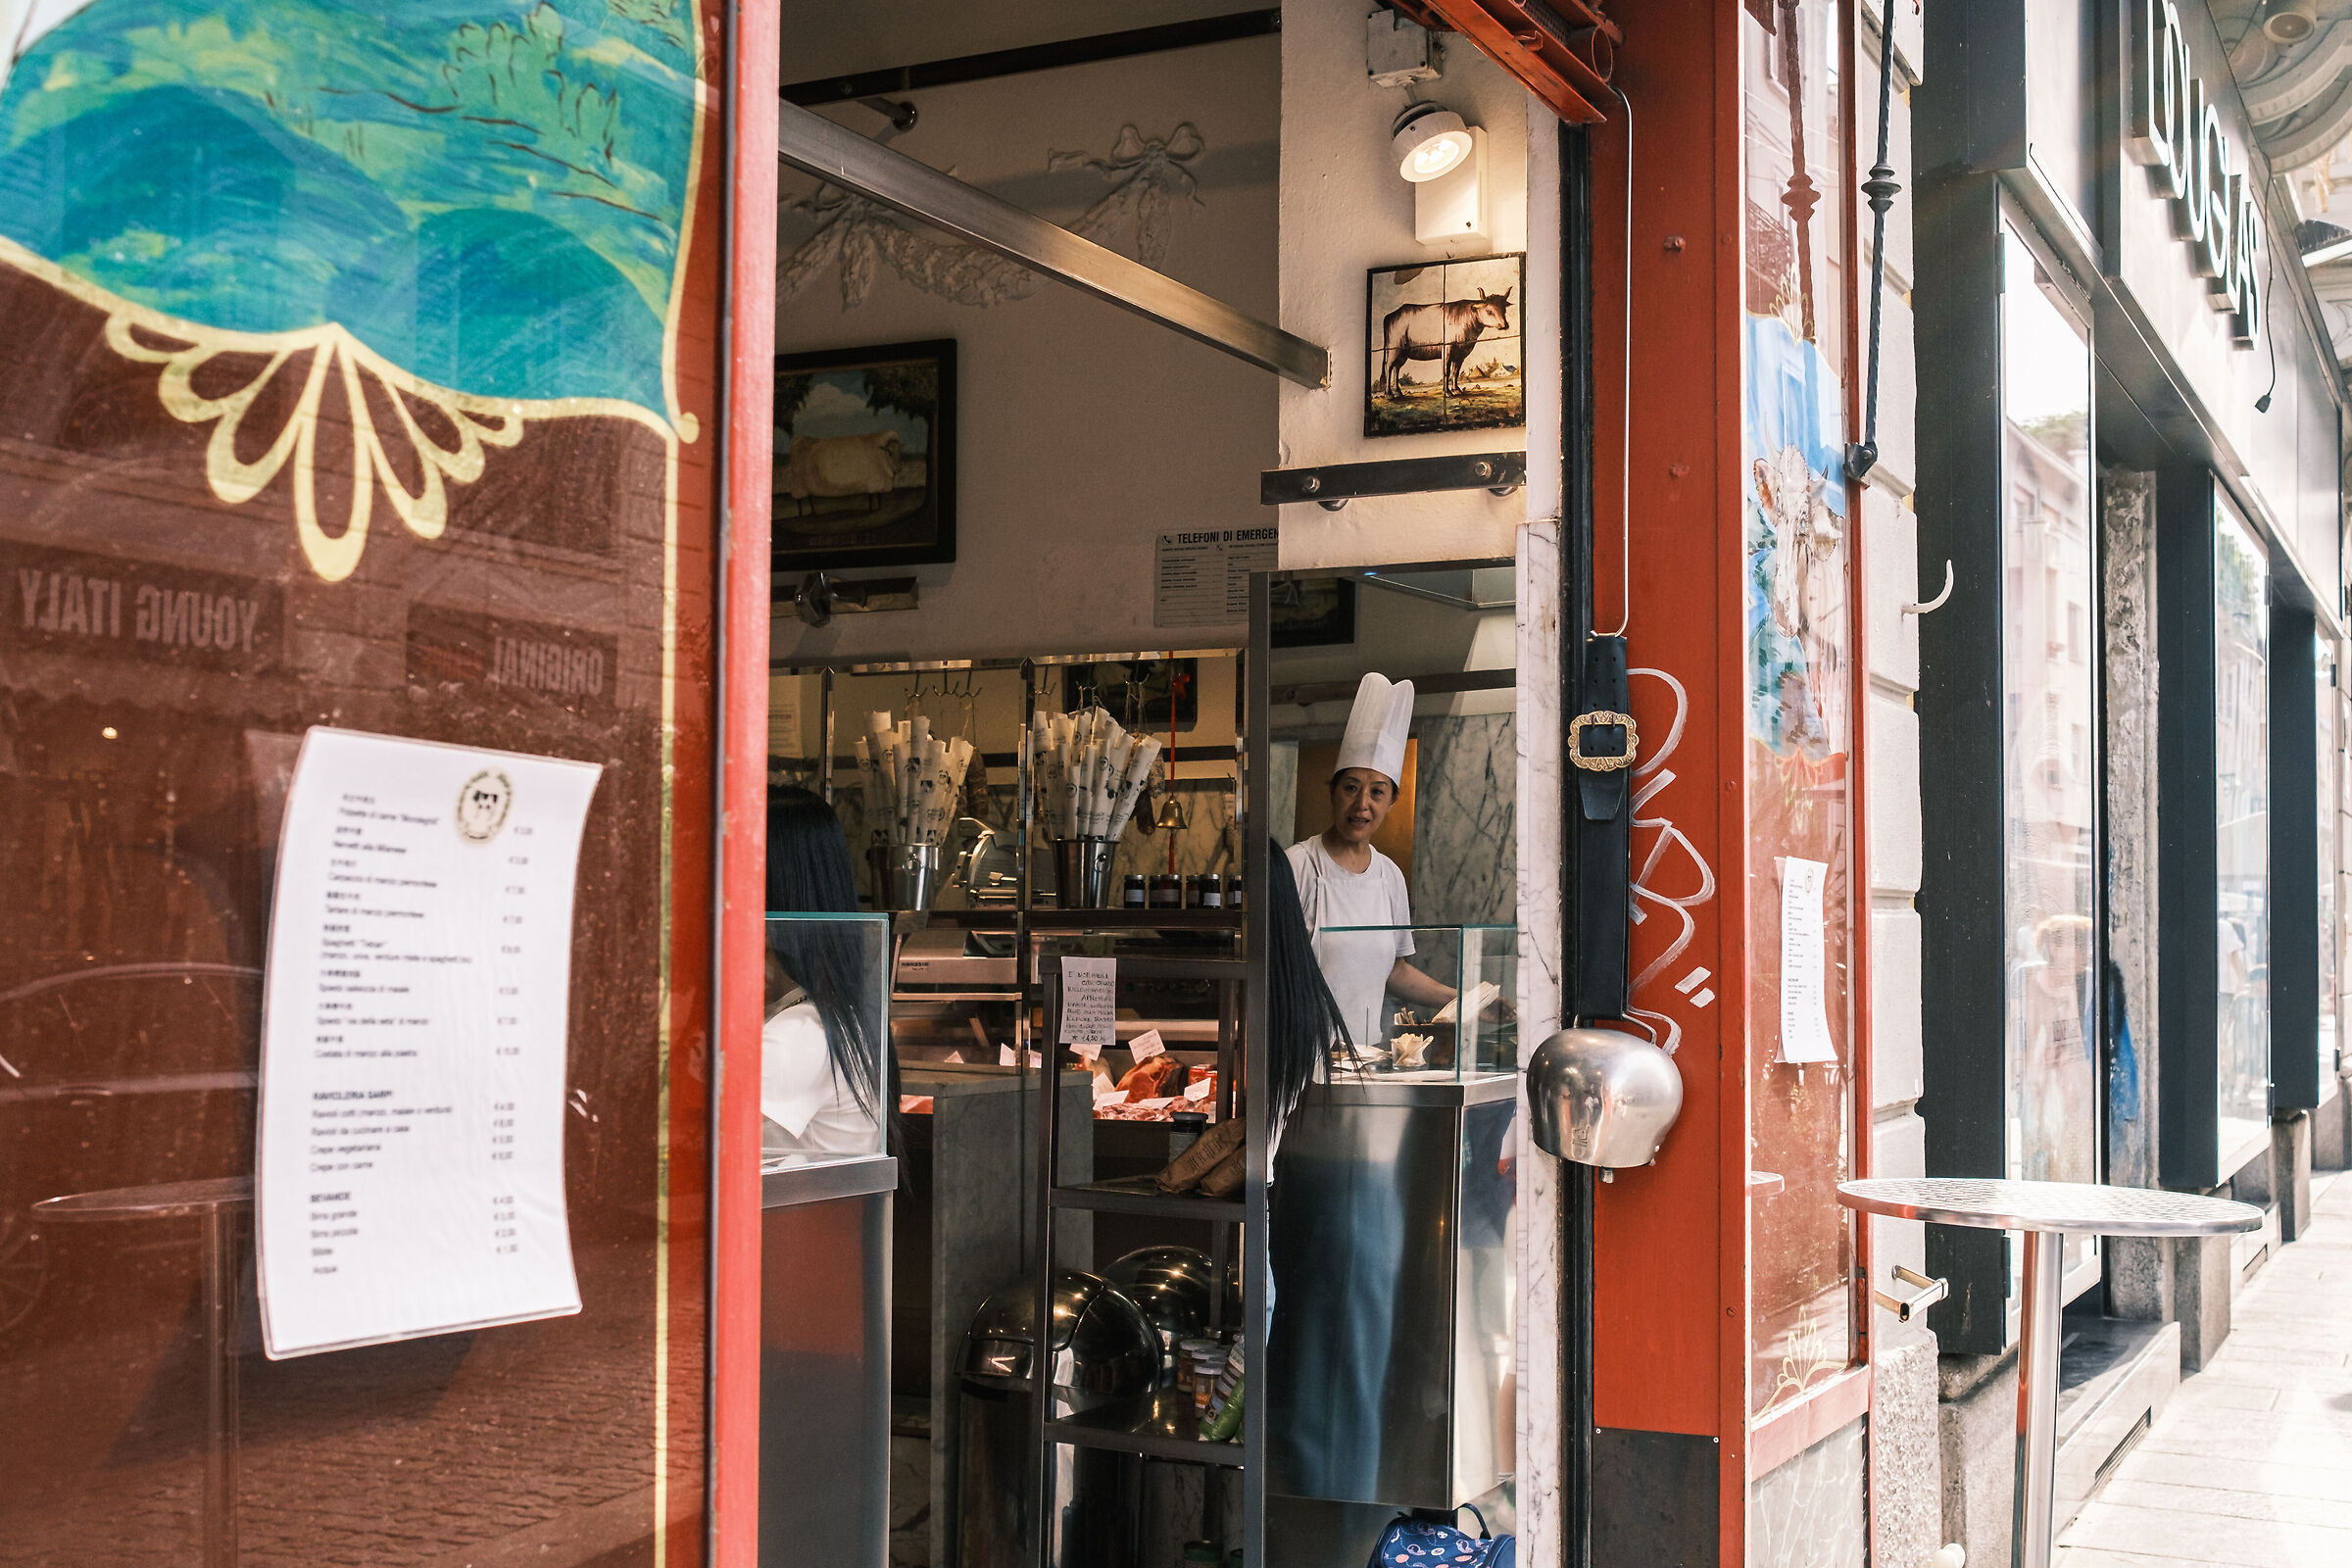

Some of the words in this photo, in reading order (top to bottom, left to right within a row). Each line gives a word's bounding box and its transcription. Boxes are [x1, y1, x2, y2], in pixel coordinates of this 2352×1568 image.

[2145, 0, 2259, 351] DOUGLAS
[1177, 530, 1219, 544] TELEFONI
[1223, 530, 1233, 541] DI
